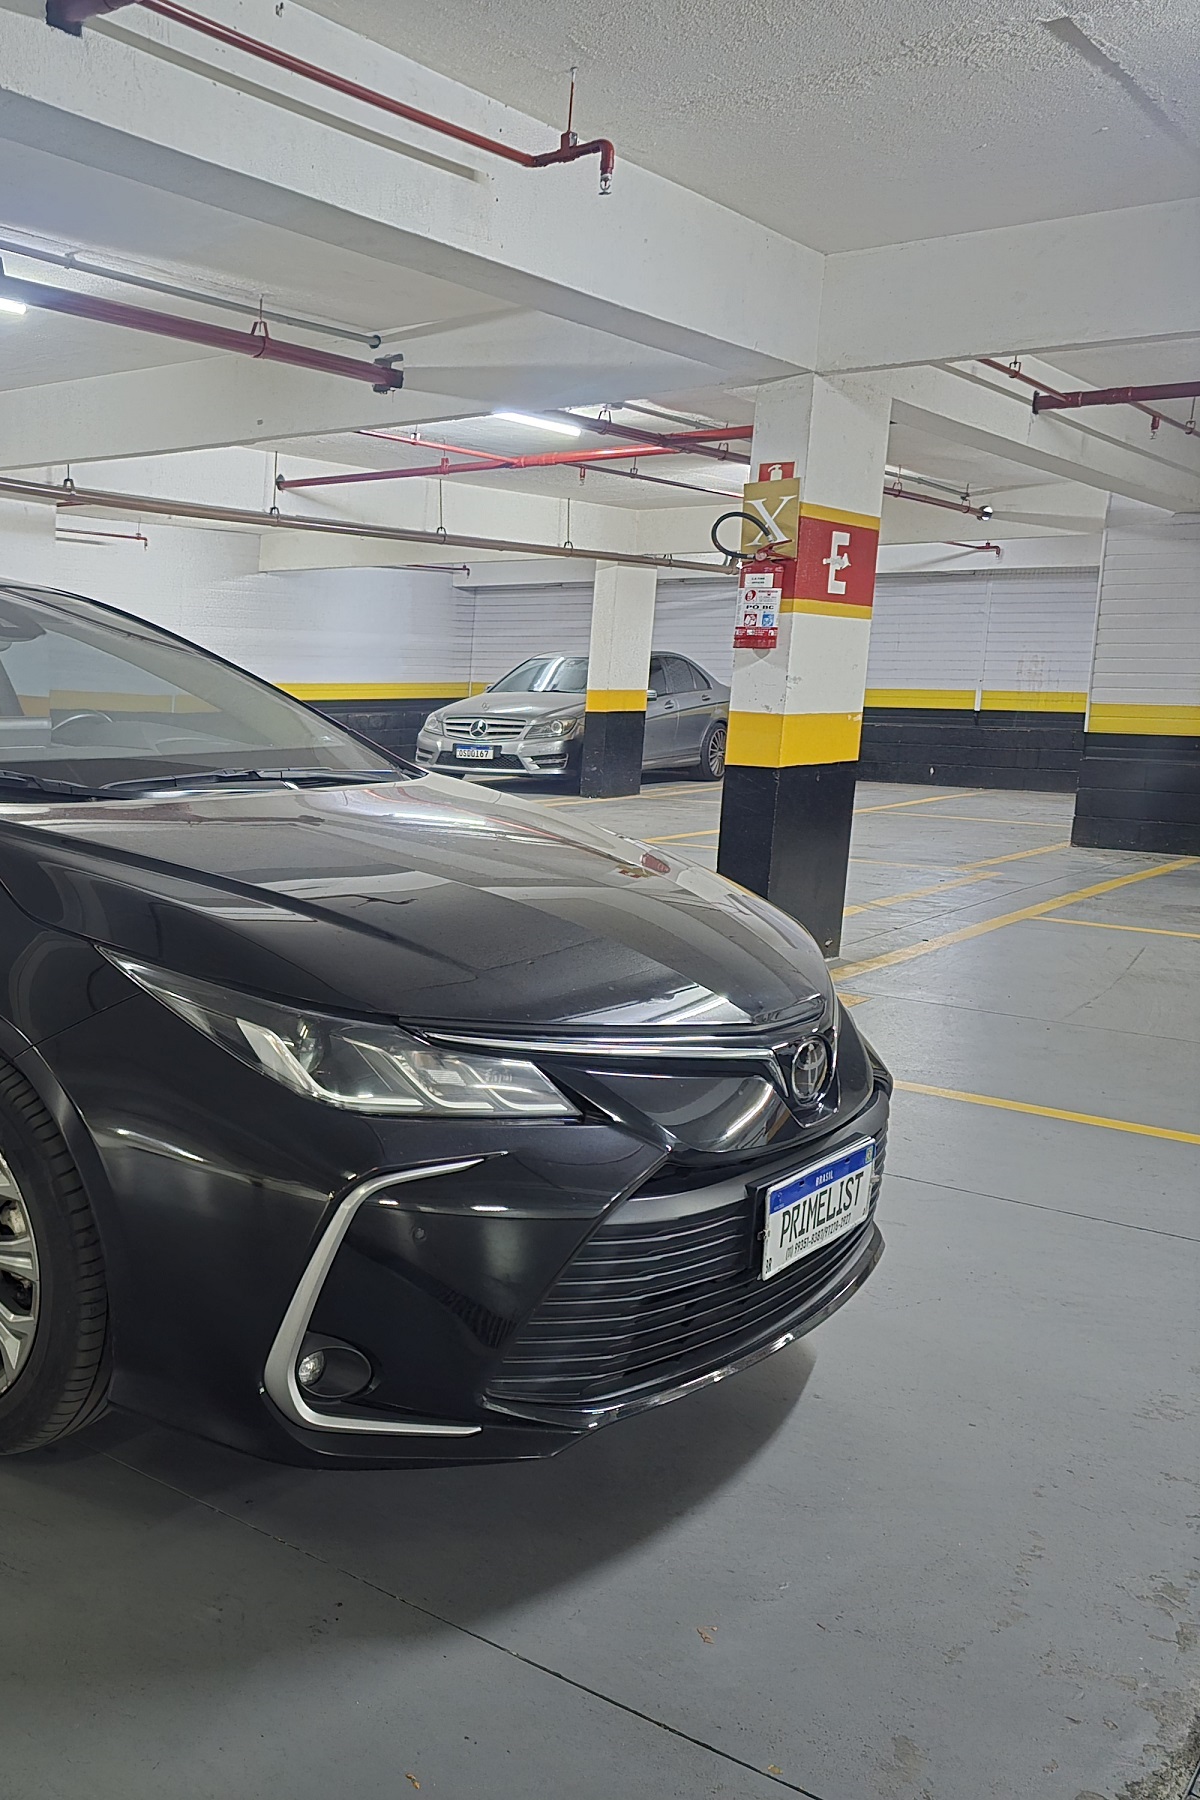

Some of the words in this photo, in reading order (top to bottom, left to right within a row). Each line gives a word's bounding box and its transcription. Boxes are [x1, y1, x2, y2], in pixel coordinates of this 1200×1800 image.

[745, 494, 798, 546] X
[823, 530, 851, 595] E
[816, 1170, 834, 1186] BRASIL
[779, 1171, 864, 1248] PRIMELIST
